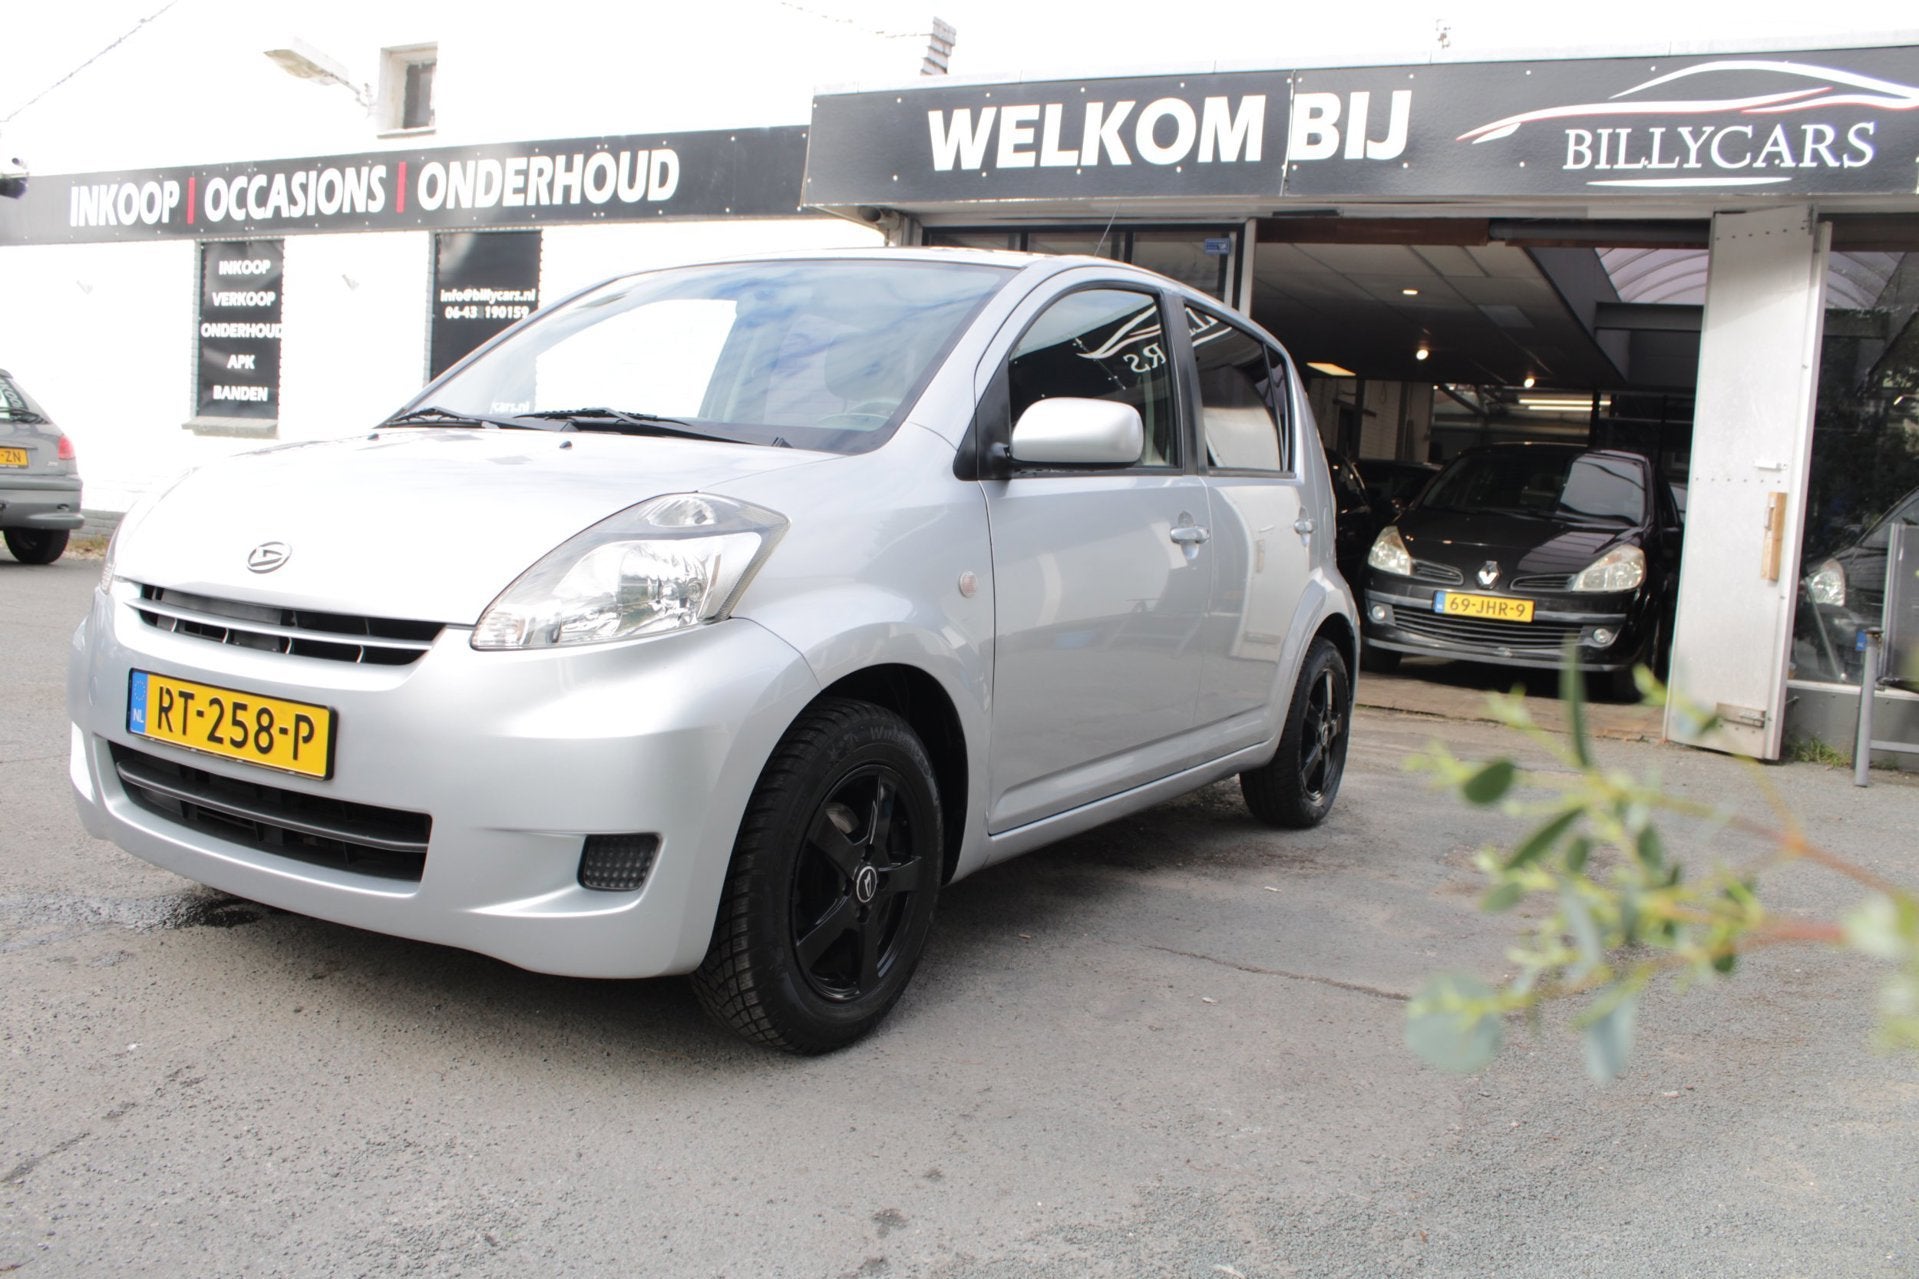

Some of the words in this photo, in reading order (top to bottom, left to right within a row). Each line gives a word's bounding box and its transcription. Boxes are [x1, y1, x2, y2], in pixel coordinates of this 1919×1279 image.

[928, 94, 1267, 172] WELKOM
[1288, 90, 1413, 161] BIJ
[1563, 120, 1876, 170] BILLYCARS
[69, 180, 180, 228] INKOOP
[204, 165, 387, 223] OCCASIONS
[417, 148, 681, 212] ONDERHOUD
[218, 259, 271, 275] INKOOP
[212, 291, 276, 306] VERKOOP
[440, 288, 536, 304] info@billycars.nl
[201, 323, 282, 338] ONDERHOUD
[227, 354, 255, 369] APK
[213, 385, 268, 401] BANDEN
[1450, 597, 1526, 617] 69-JHR-9
[133, 708, 144, 723] NL
[157, 686, 315, 761] RT-258-P
